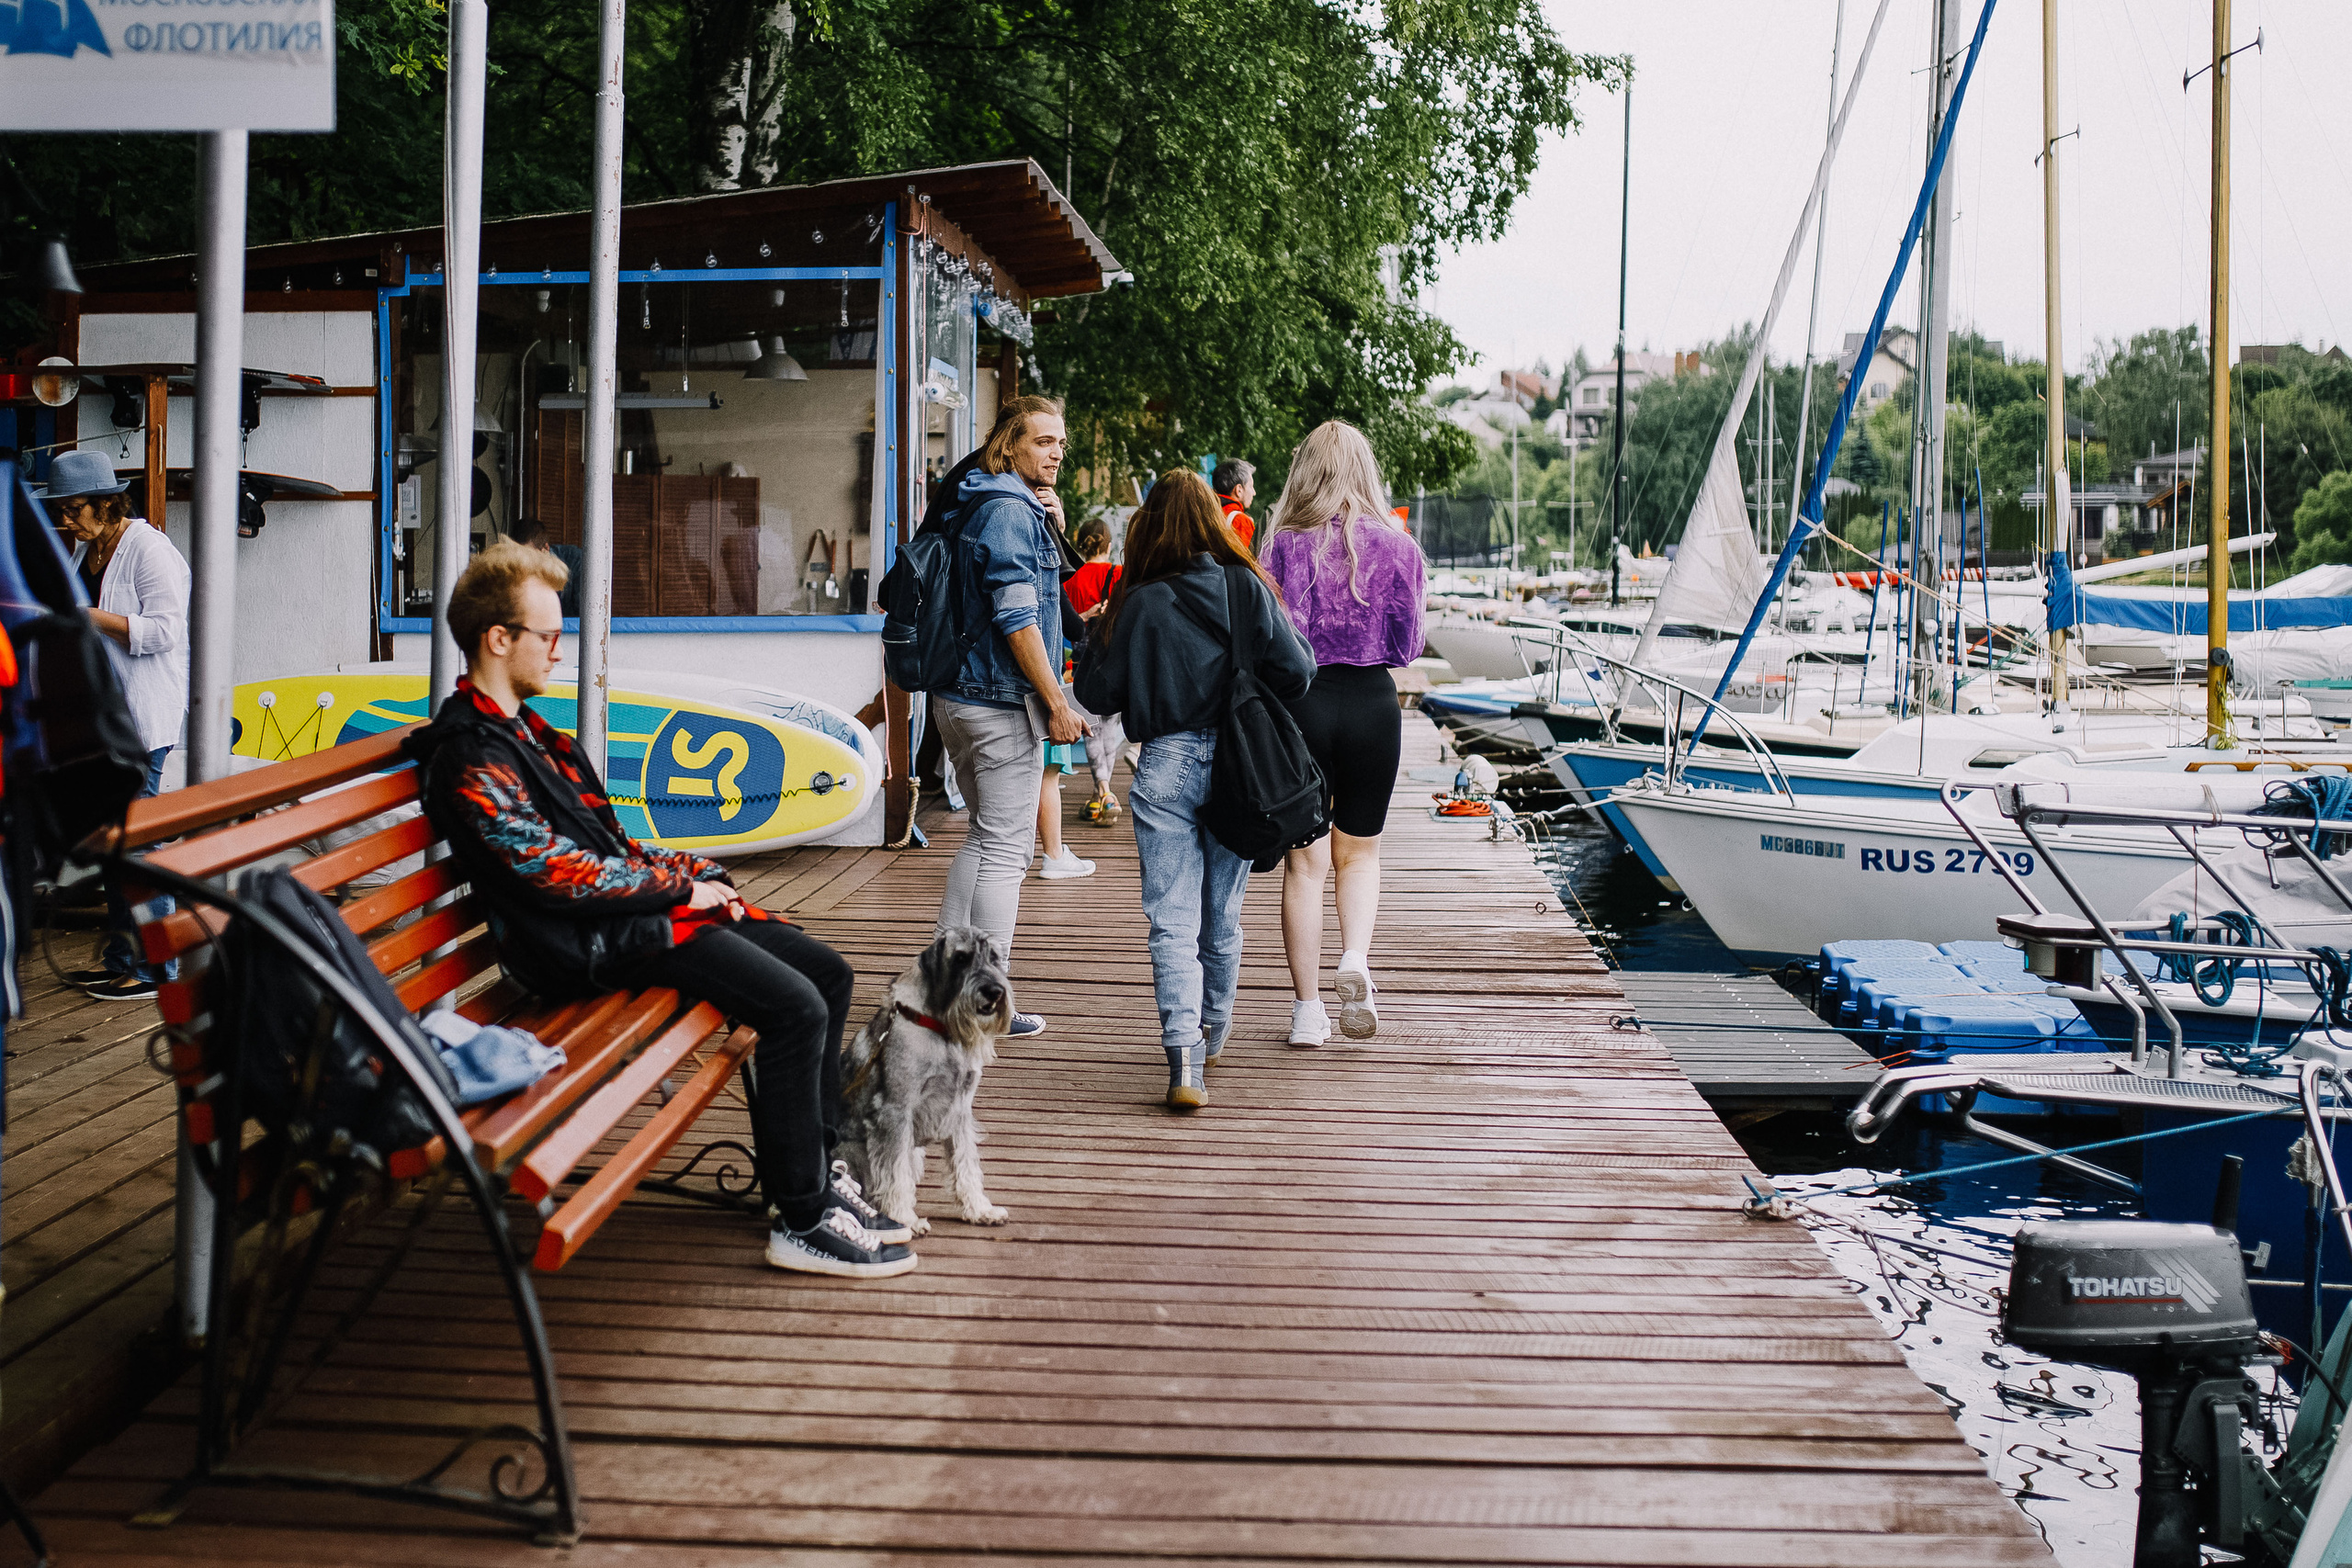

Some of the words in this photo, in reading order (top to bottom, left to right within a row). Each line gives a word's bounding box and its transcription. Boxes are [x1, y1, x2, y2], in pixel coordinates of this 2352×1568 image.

[124, 22, 322, 52] ФЛОТИЛИЯ
[1860, 848, 1936, 874] RUS
[2069, 1277, 2183, 1297] TOHATSU
